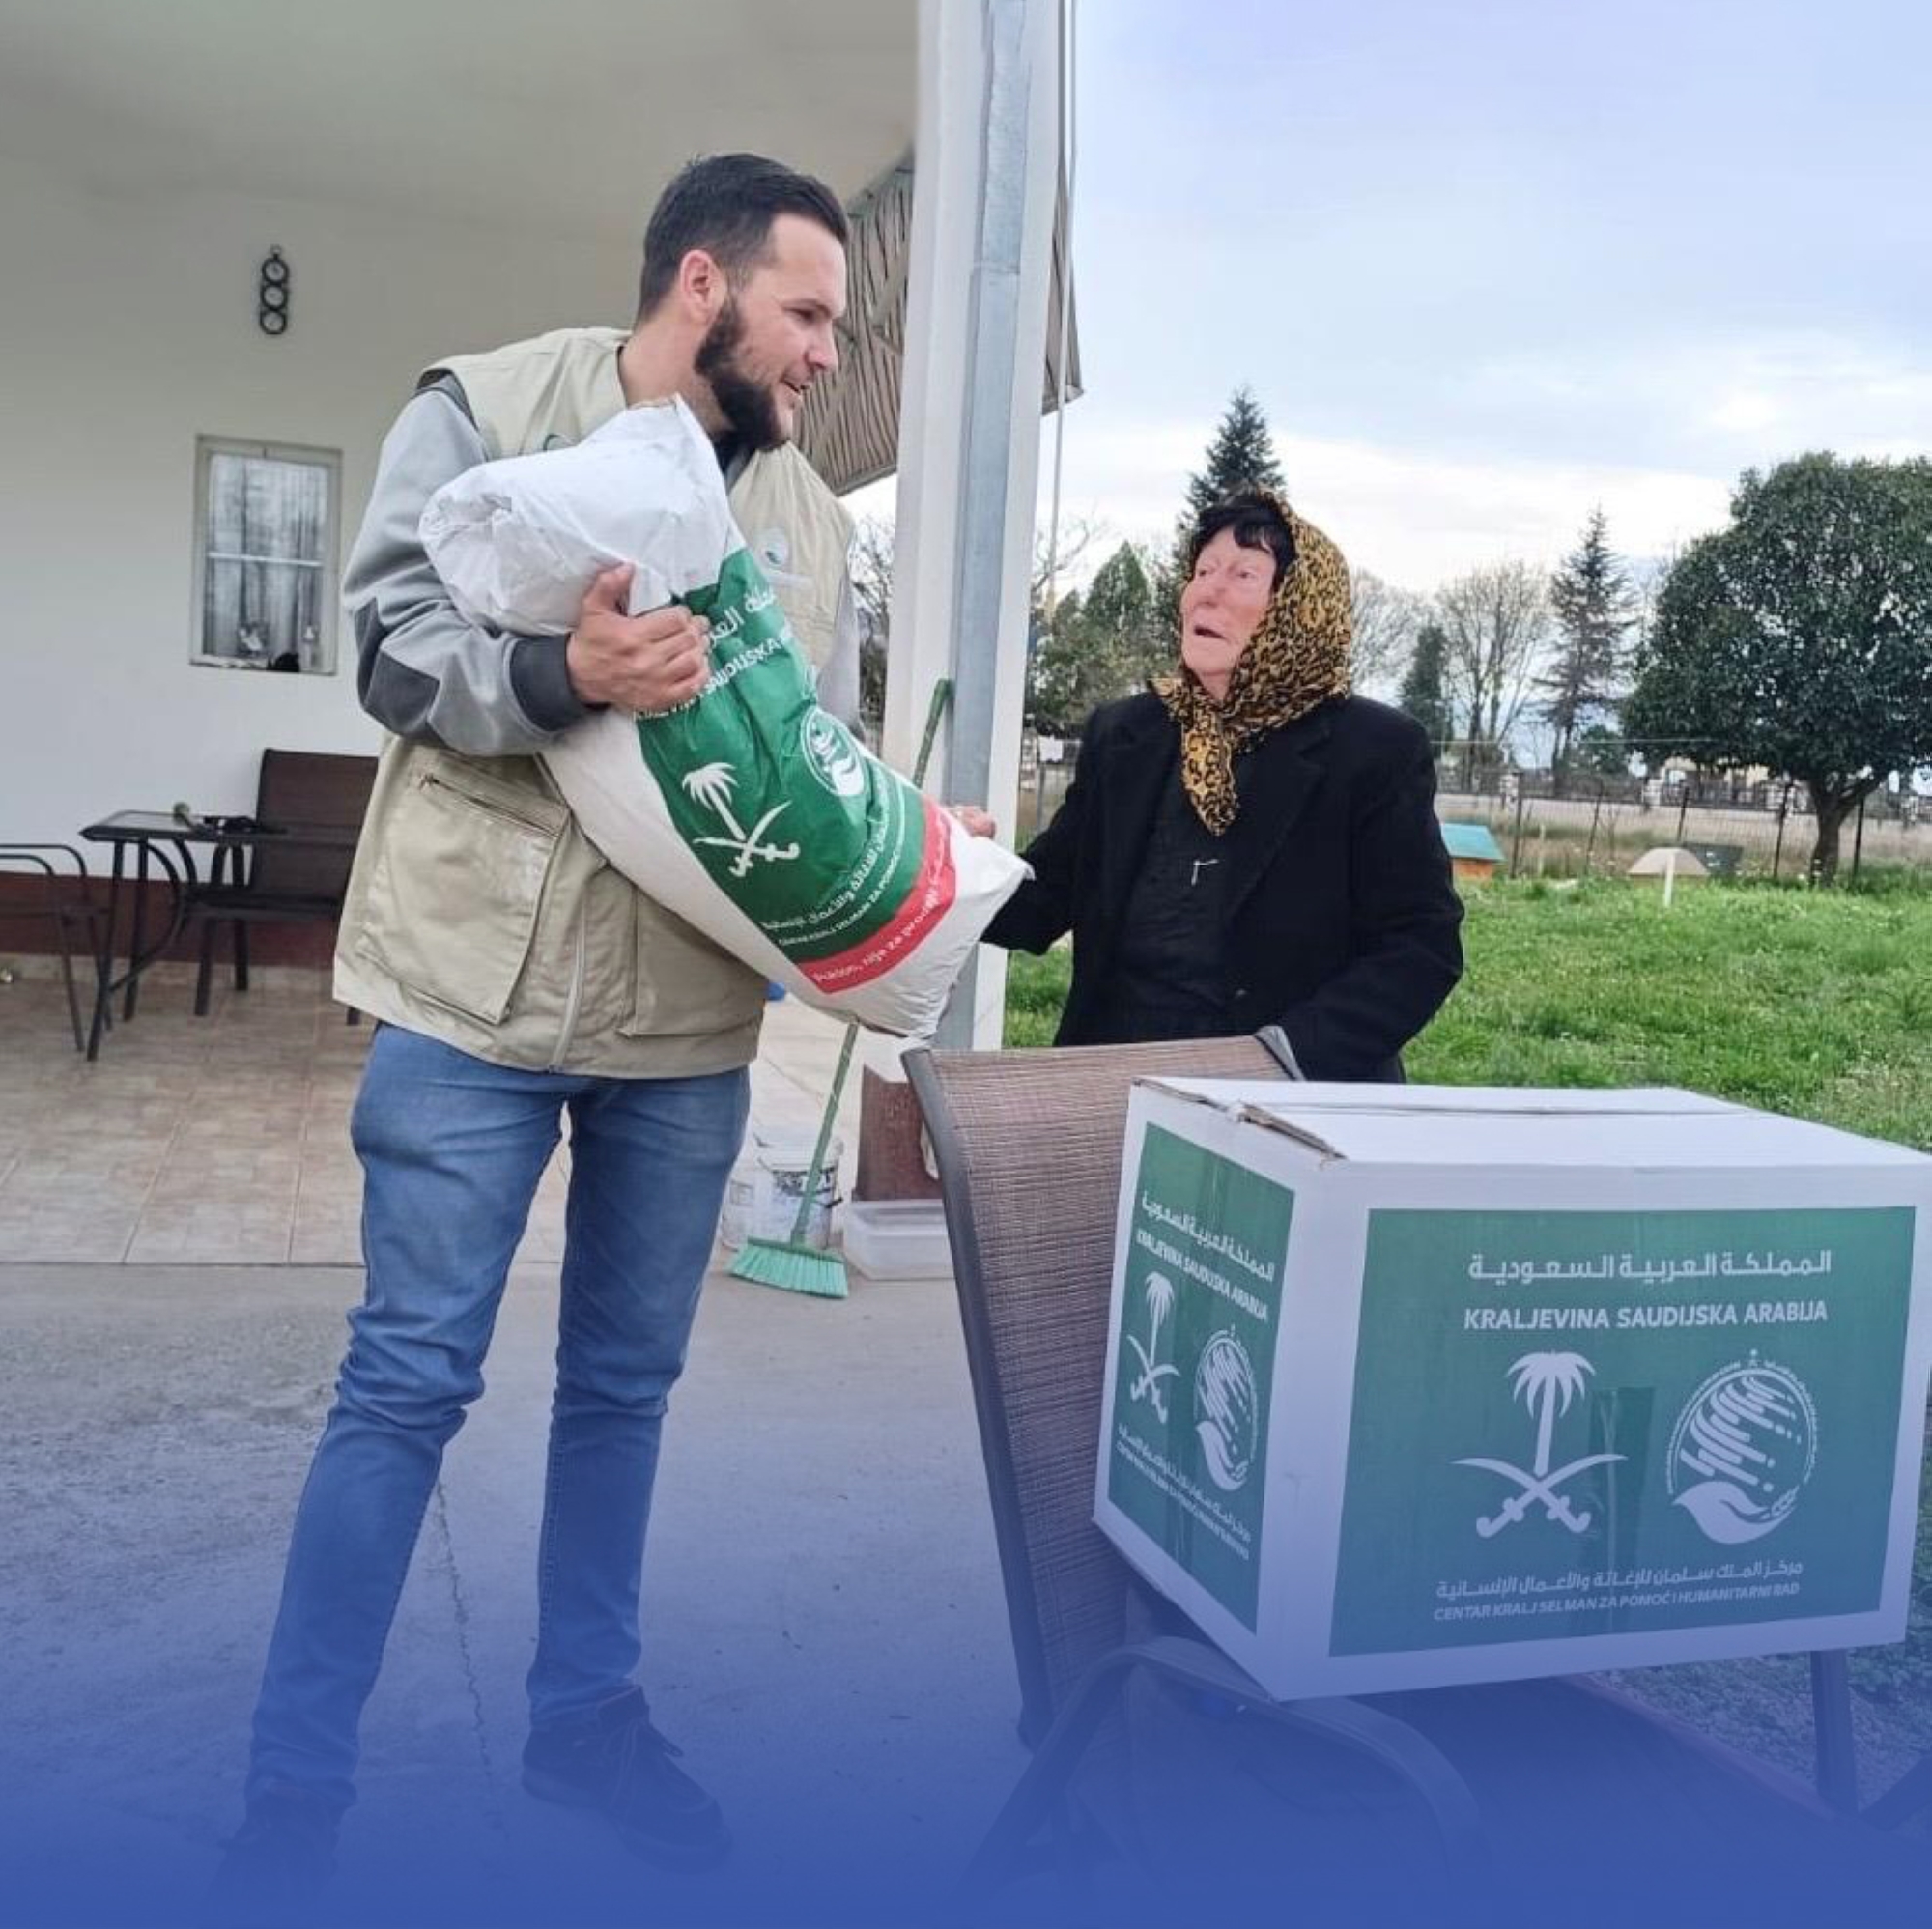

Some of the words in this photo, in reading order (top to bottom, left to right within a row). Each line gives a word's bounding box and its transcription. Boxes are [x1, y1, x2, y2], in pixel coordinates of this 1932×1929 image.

[1467, 1253, 1615, 1286] السعودية
[1619, 1252, 1717, 1284] العربية
[1720, 1249, 1832, 1277] المملكة
[1463, 1307, 1610, 1330] KRALJEVINA
[1616, 1304, 1739, 1329] SAUDIJSKA
[1743, 1299, 1829, 1324] ARABIJA
[1434, 1603, 1492, 1621] CENTAR
[1492, 1600, 1538, 1617] KRALJ
[1538, 1596, 1598, 1614] SELMAN
[1598, 1595, 1618, 1609] ZA
[1678, 1584, 1773, 1604] HUMANITARNI
[1772, 1581, 1801, 1597] RAD
